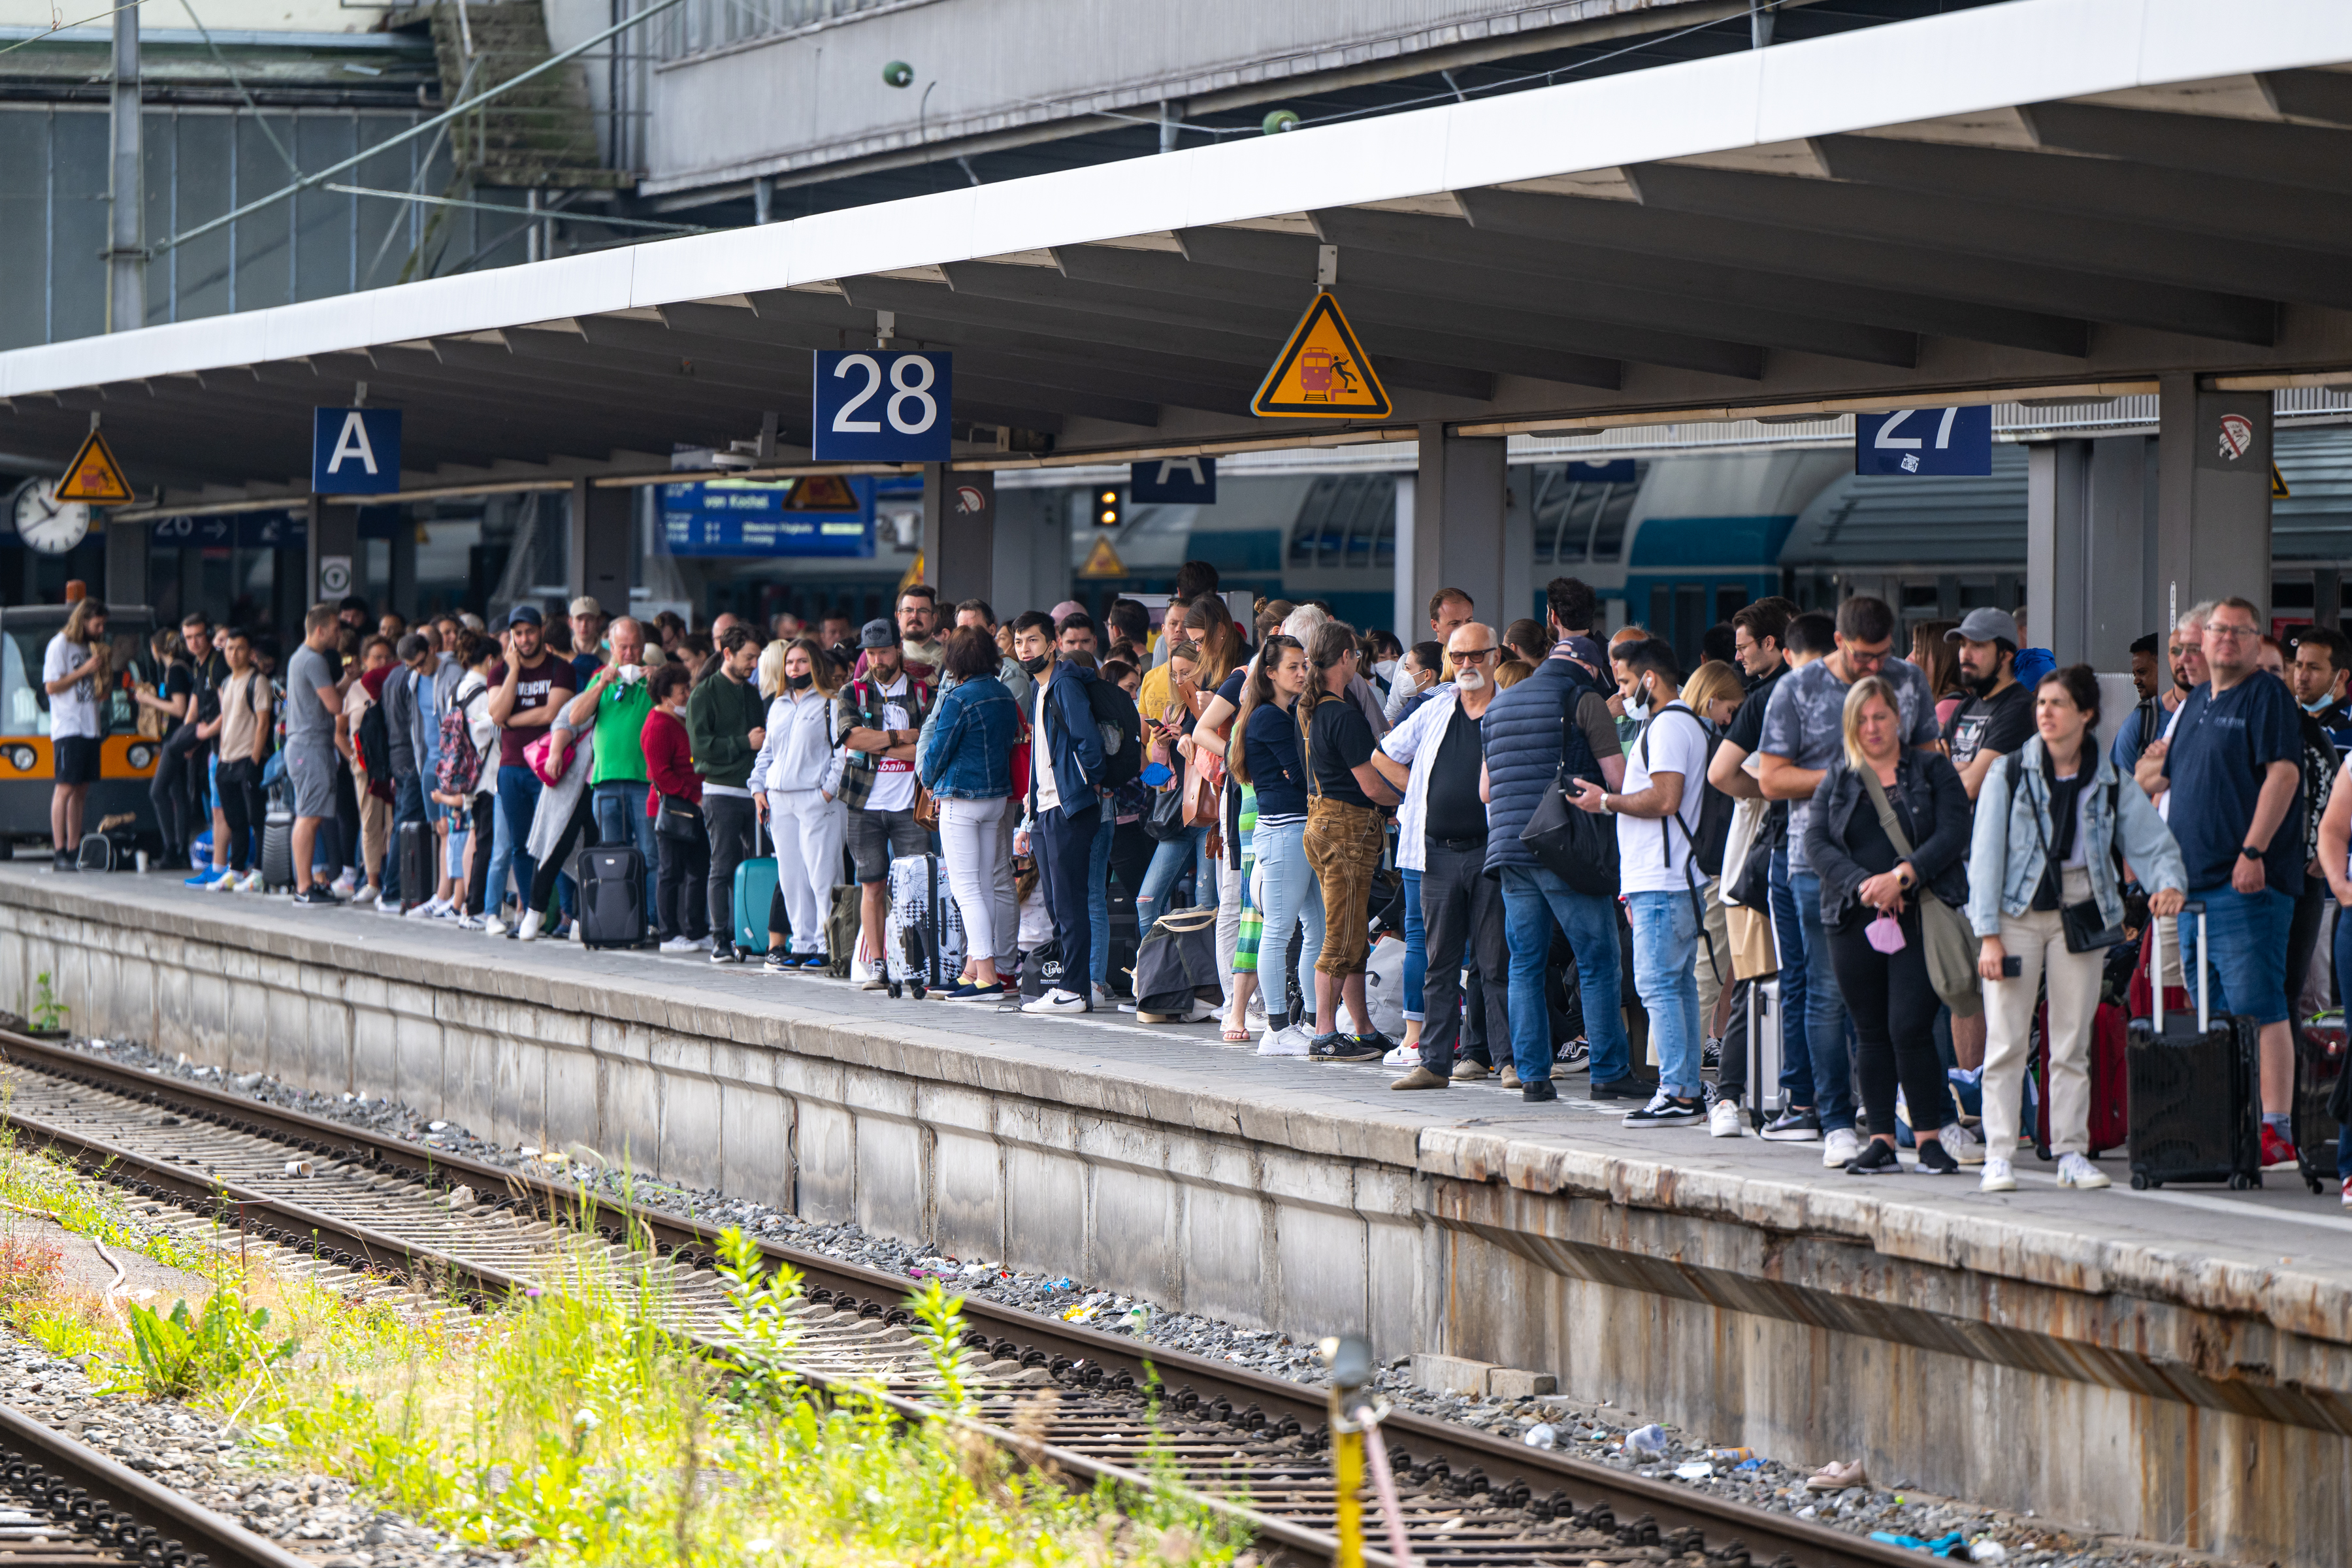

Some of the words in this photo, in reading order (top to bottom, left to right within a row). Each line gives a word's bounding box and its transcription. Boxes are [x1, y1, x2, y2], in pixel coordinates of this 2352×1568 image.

[832, 353, 937, 434] 28
[327, 412, 378, 474] A
[517, 679, 552, 696] VENCHY
[879, 761, 906, 772] bain
